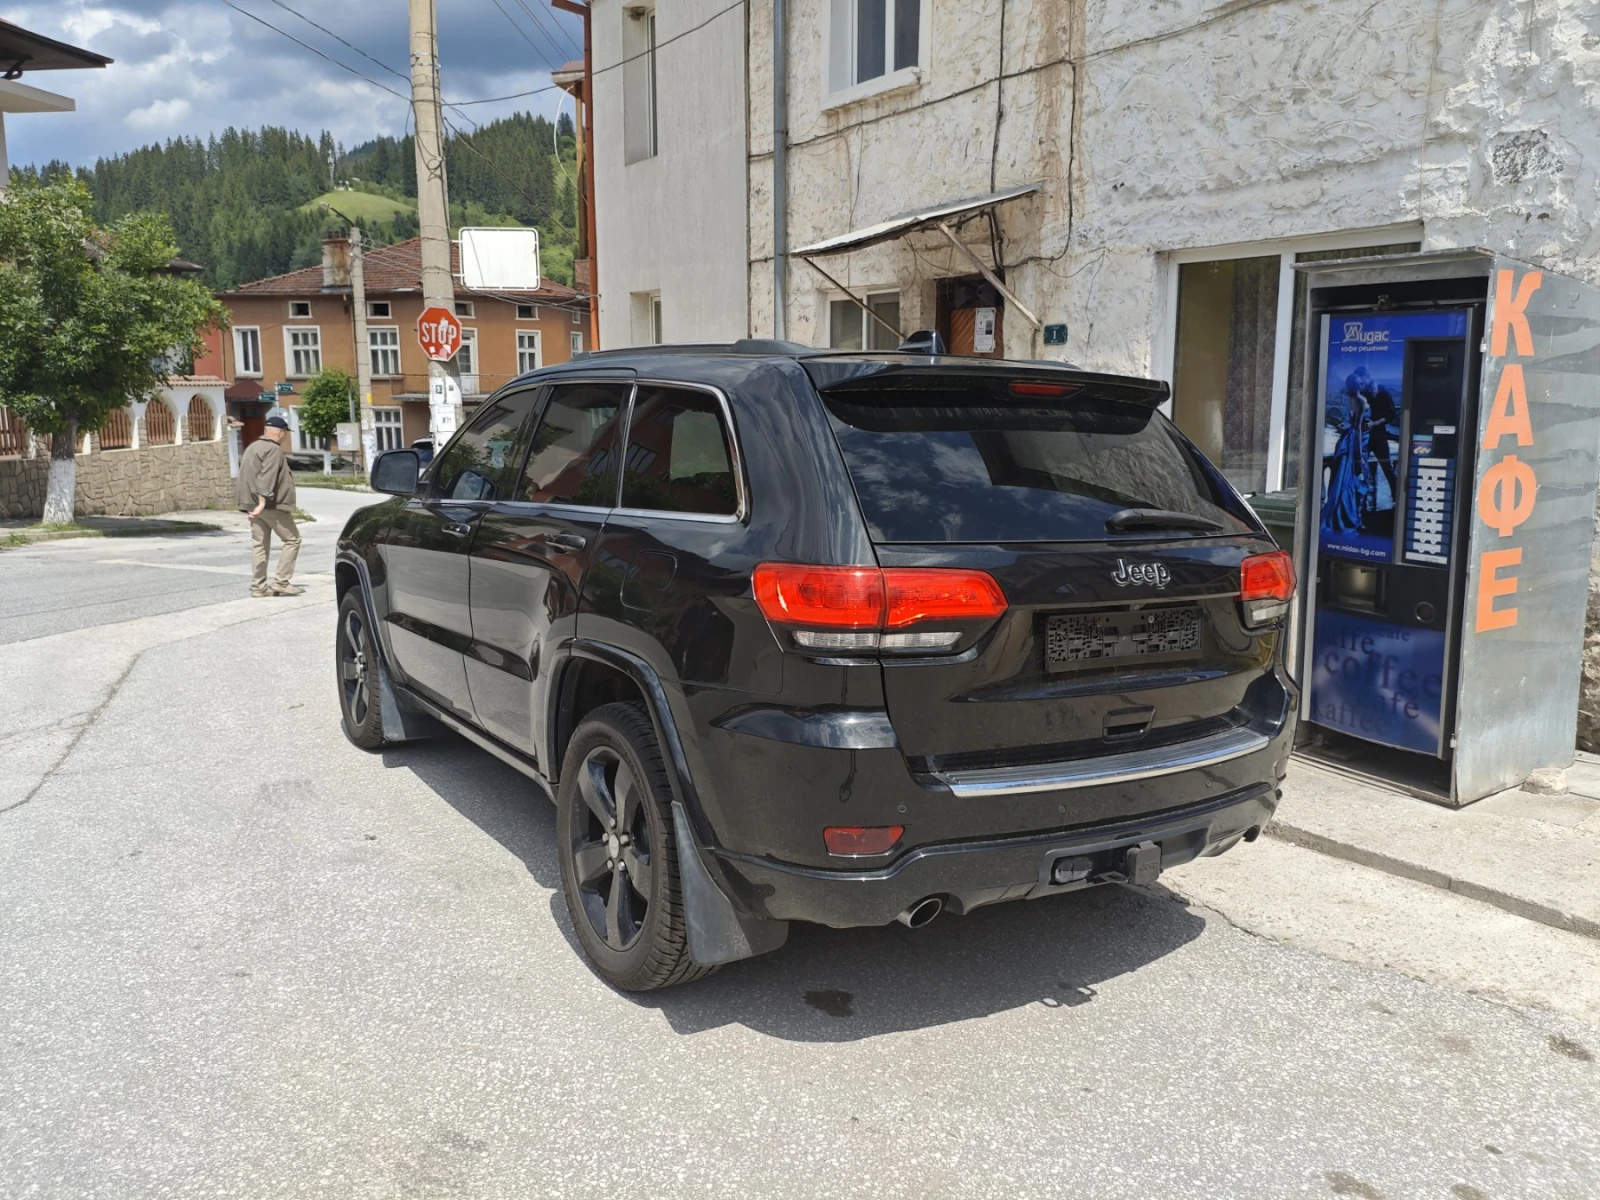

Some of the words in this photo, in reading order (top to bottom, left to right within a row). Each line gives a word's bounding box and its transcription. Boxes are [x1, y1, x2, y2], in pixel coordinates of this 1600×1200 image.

[421, 321, 457, 345] STOP
[1475, 269, 1543, 634] КАФЕ
[1327, 542, 1386, 558] www.midas-bg.com
[1111, 558, 1171, 590] Jeep
